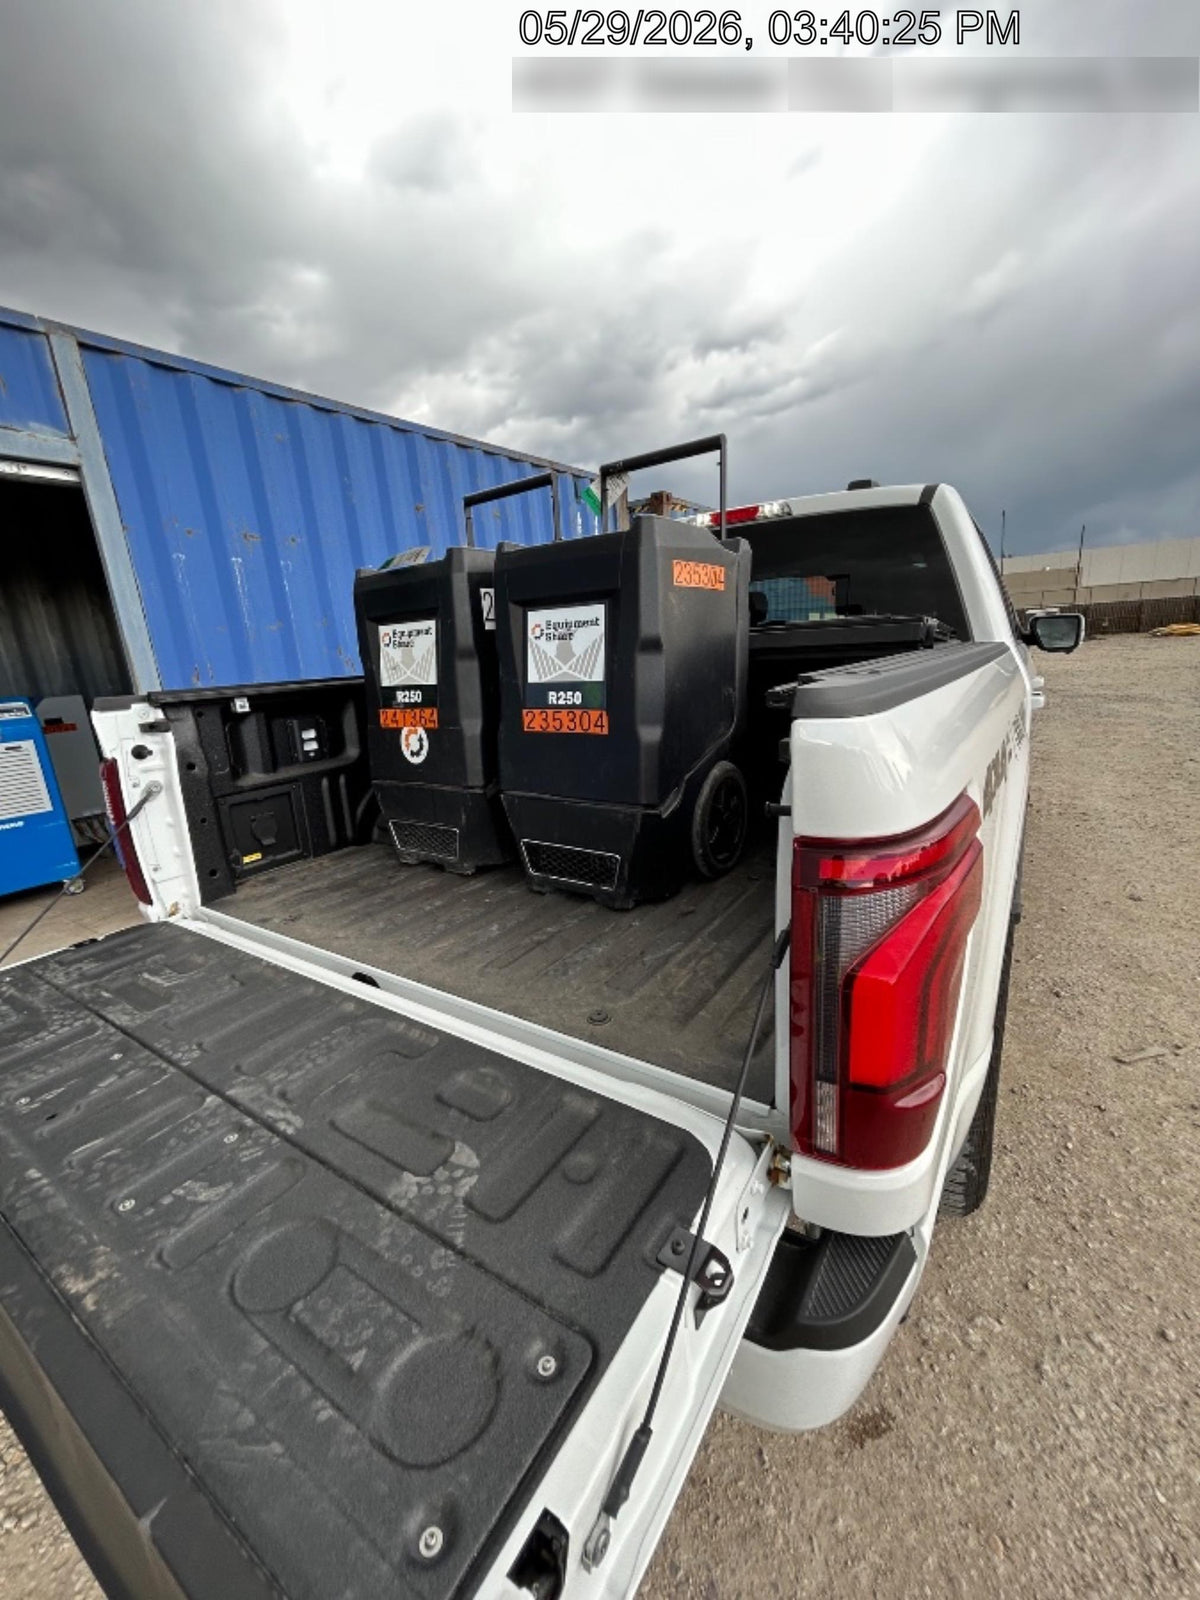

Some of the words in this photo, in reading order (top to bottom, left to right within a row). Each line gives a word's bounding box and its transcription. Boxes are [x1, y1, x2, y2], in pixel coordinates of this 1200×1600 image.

[675, 561, 725, 587] 235304
[396, 690, 422, 703] R250
[548, 691, 582, 705] R250
[525, 710, 605, 732] 235304
